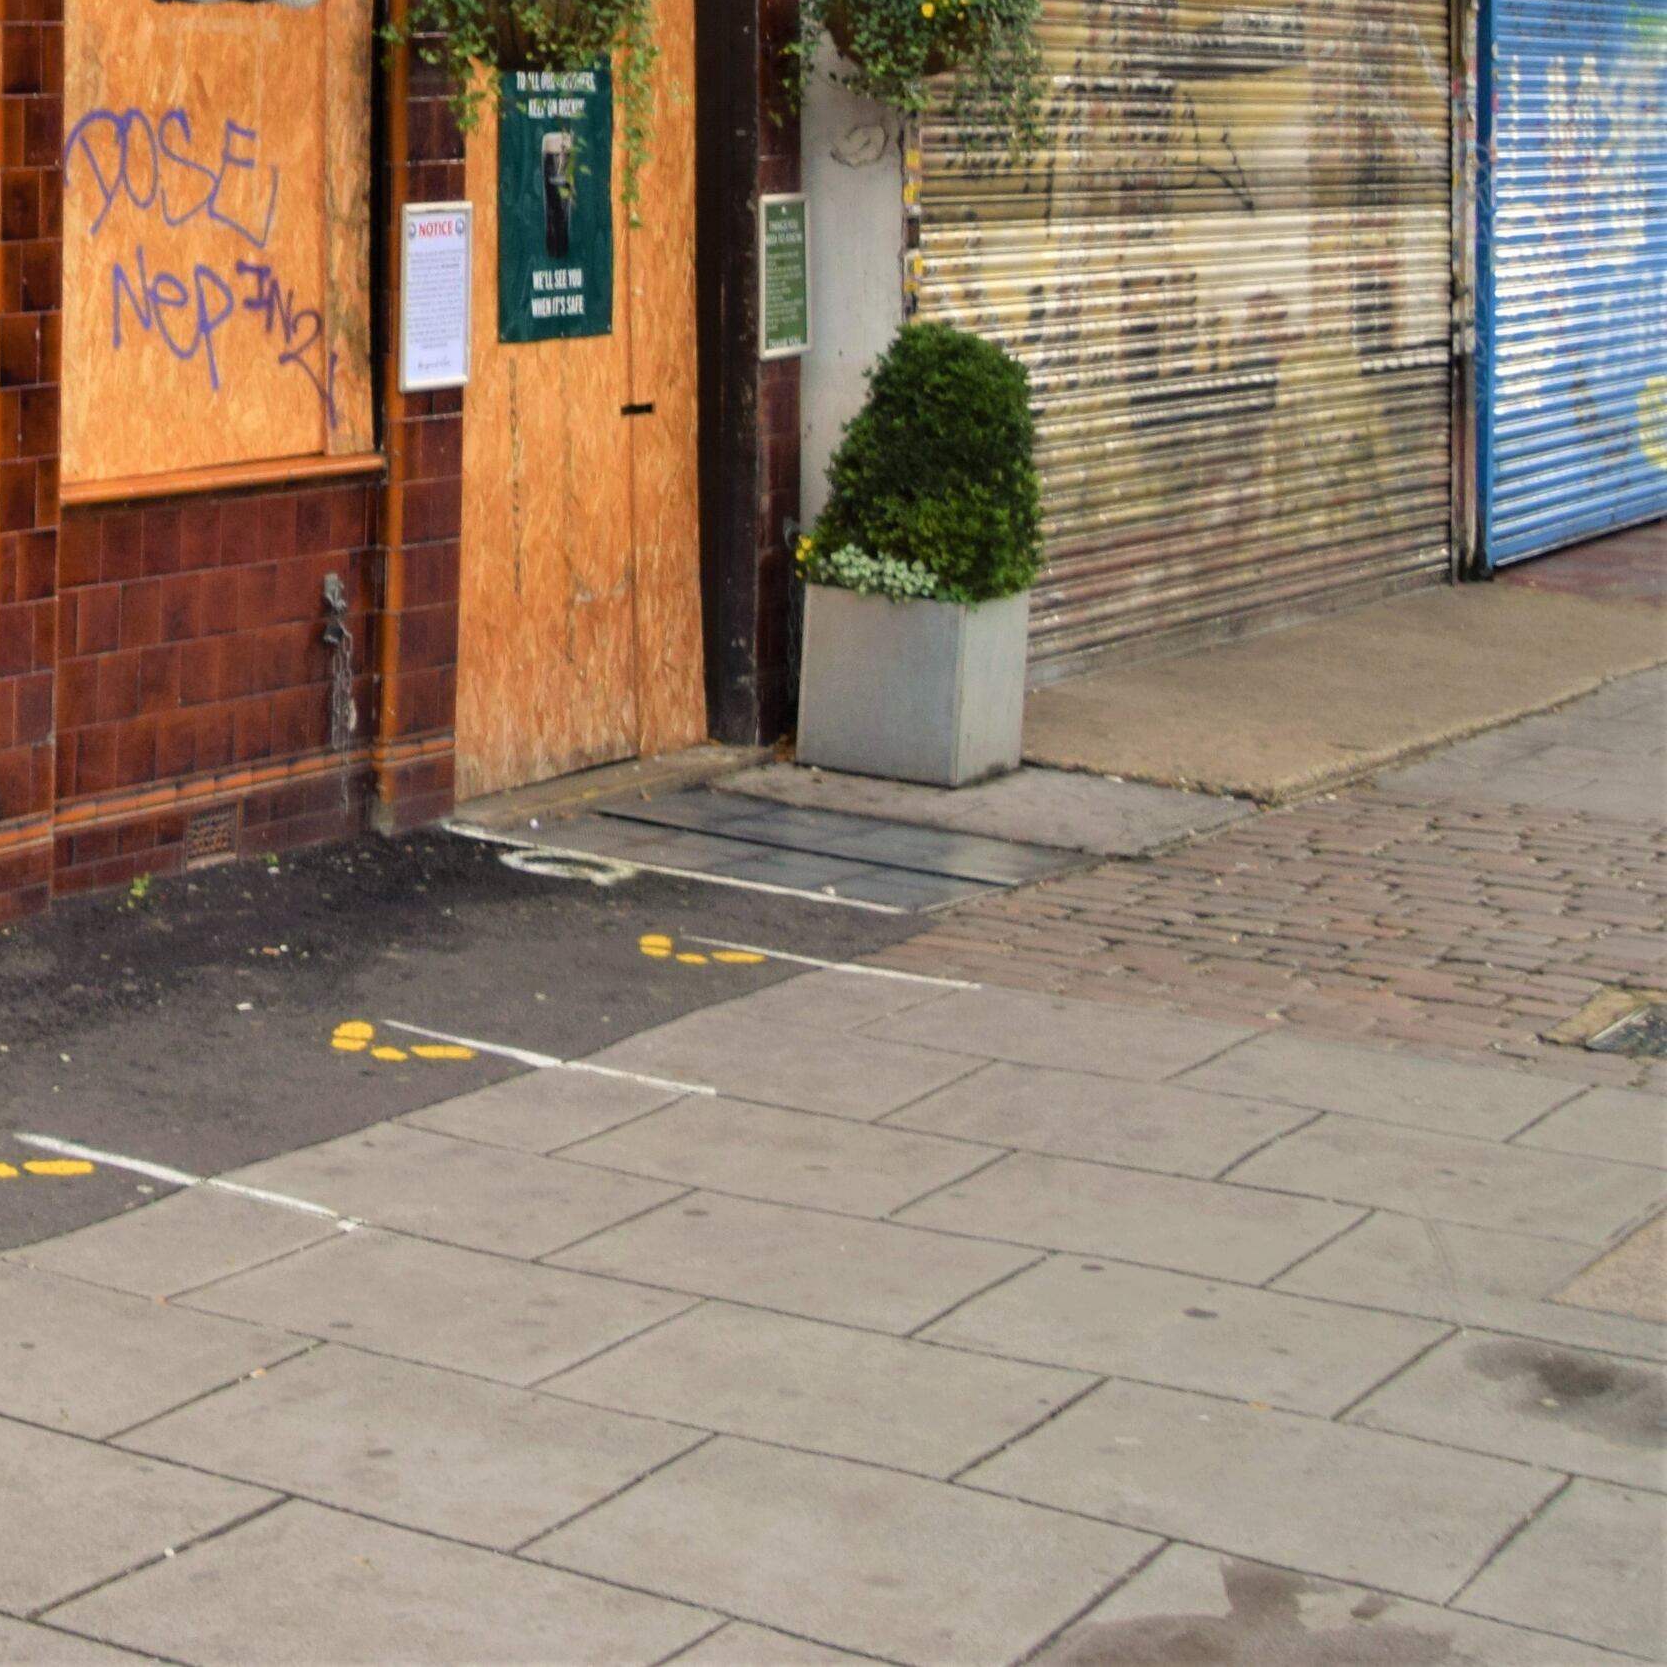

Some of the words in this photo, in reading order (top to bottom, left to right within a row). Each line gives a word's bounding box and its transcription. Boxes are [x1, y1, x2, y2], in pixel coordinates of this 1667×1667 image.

[418, 220, 453, 238] NOTICE
[532, 270, 554, 291] WE'LL
[554, 269, 567, 290] SEE
[568, 267, 583, 289] YOU
[531, 296, 552, 319] WHEN
[552, 295, 566, 317] IT'S
[567, 294, 586, 316] SAFE
